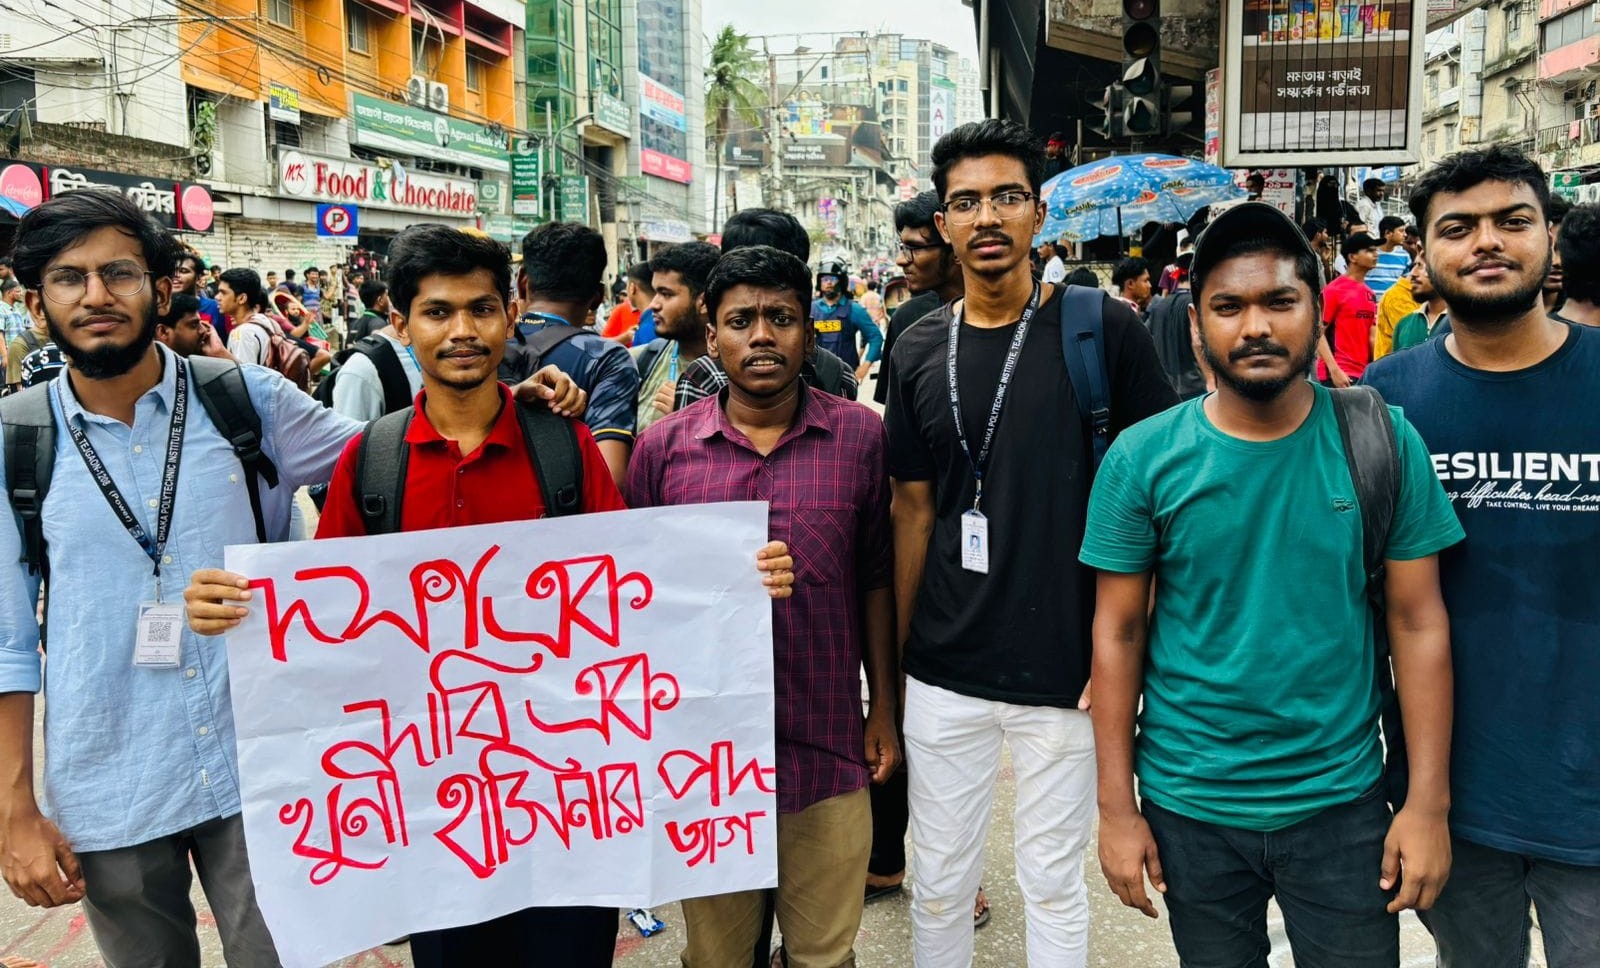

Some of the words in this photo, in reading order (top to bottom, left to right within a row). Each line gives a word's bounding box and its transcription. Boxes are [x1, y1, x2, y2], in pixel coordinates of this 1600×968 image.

[284, 163, 304, 181] MK
[313, 161, 368, 200] Food
[372, 169, 387, 201] &
[391, 173, 476, 212] Chocolate
[1001, 351, 1017, 384] INSTITUTE,
[173, 377, 186, 425] TEJGAON-1208
[169, 426, 183, 464] INSTITUTE,
[79, 439, 111, 487] TEJGAON-1208
[108, 489, 134, 524] (Power)
[161, 463, 177, 516] POLYTECHNIC
[1460, 479, 1533, 508] difficulties
[1504, 502, 1534, 511] CONTROL,
[1536, 503, 1550, 511] LIVE
[159, 516, 169, 541] DHAKA
[343, 649, 543, 767] দাবি
[526, 652, 680, 746] এক
[433, 742, 644, 879] হাসিনার
